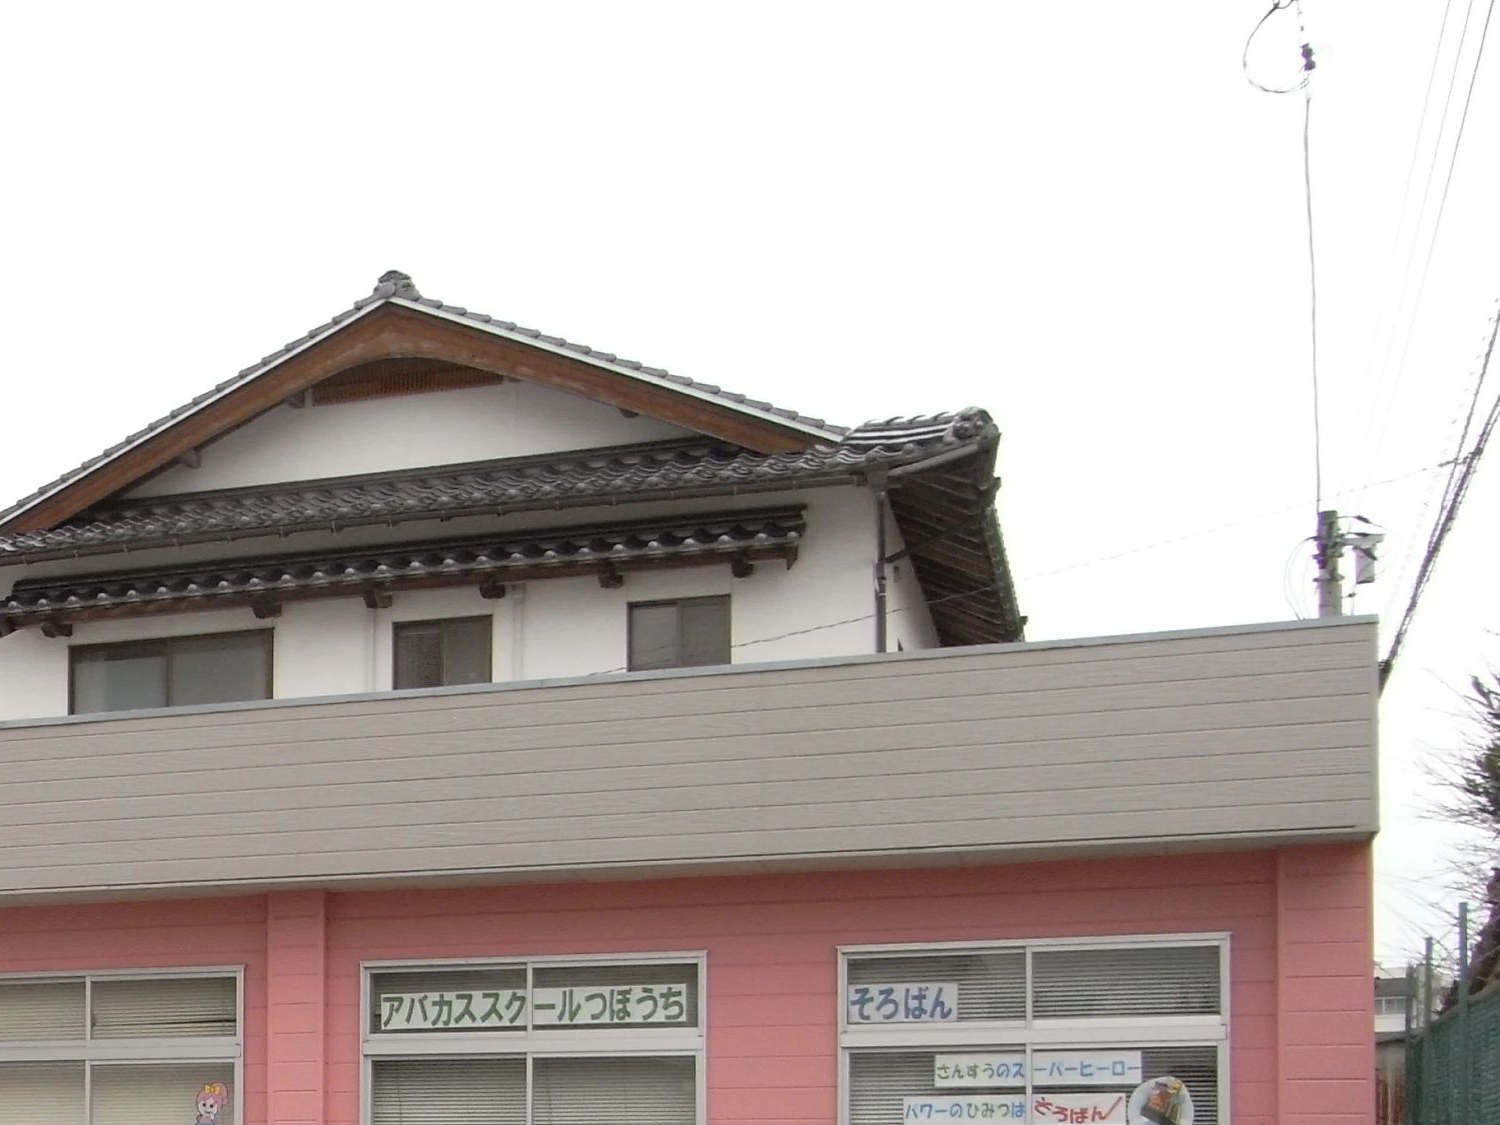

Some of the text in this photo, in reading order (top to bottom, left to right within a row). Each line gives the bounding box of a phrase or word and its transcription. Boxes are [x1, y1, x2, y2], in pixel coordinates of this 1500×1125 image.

[382, 986, 684, 1028] アバカススクールつぼうち
[849, 985, 953, 1020] そろばん
